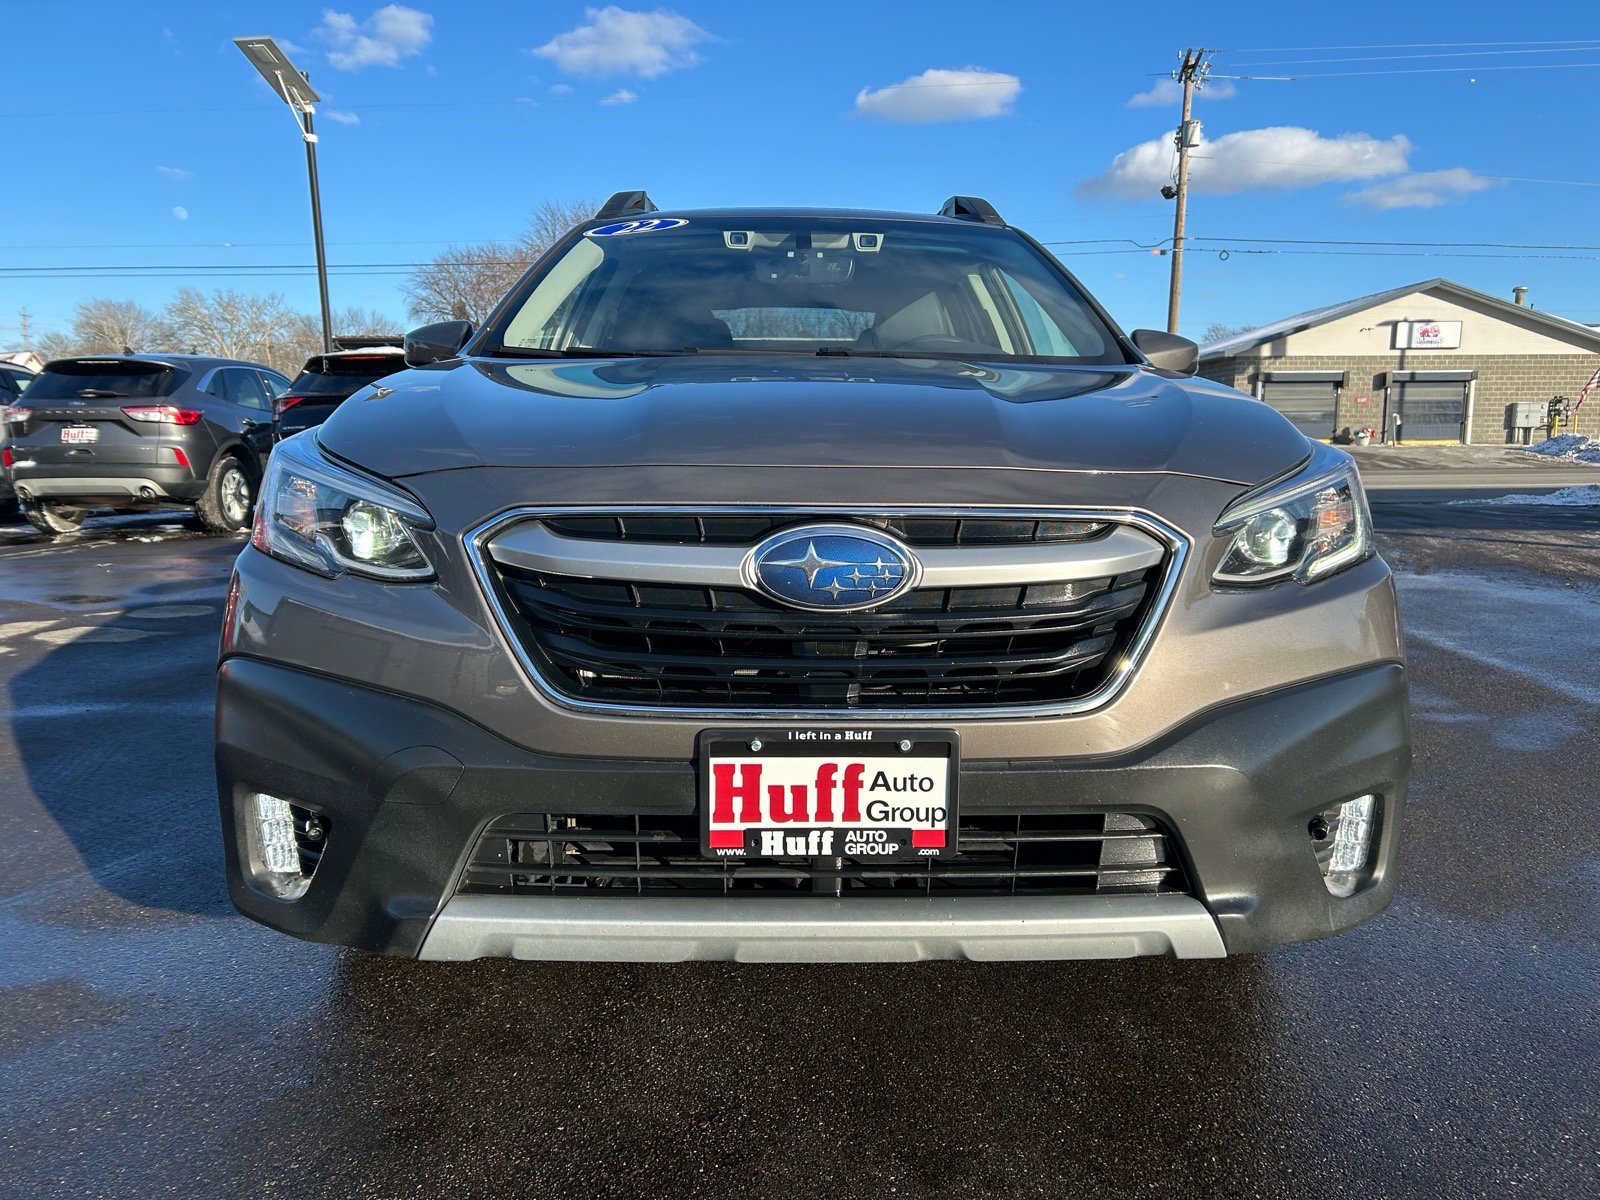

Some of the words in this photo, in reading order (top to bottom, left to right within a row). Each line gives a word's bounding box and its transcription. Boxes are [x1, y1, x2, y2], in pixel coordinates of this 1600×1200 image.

[788, 731, 792, 740] I
[796, 731, 817, 740] left
[819, 731, 831, 740] in
[844, 731, 873, 740] Huff
[869, 771, 934, 792] Auto
[713, 763, 865, 823] Huff
[866, 800, 947, 828] Group
[761, 831, 834, 856] Huff
[845, 831, 887, 842] AUTO
[844, 843, 899, 855] GROUP
[917, 848, 940, 856] .com
